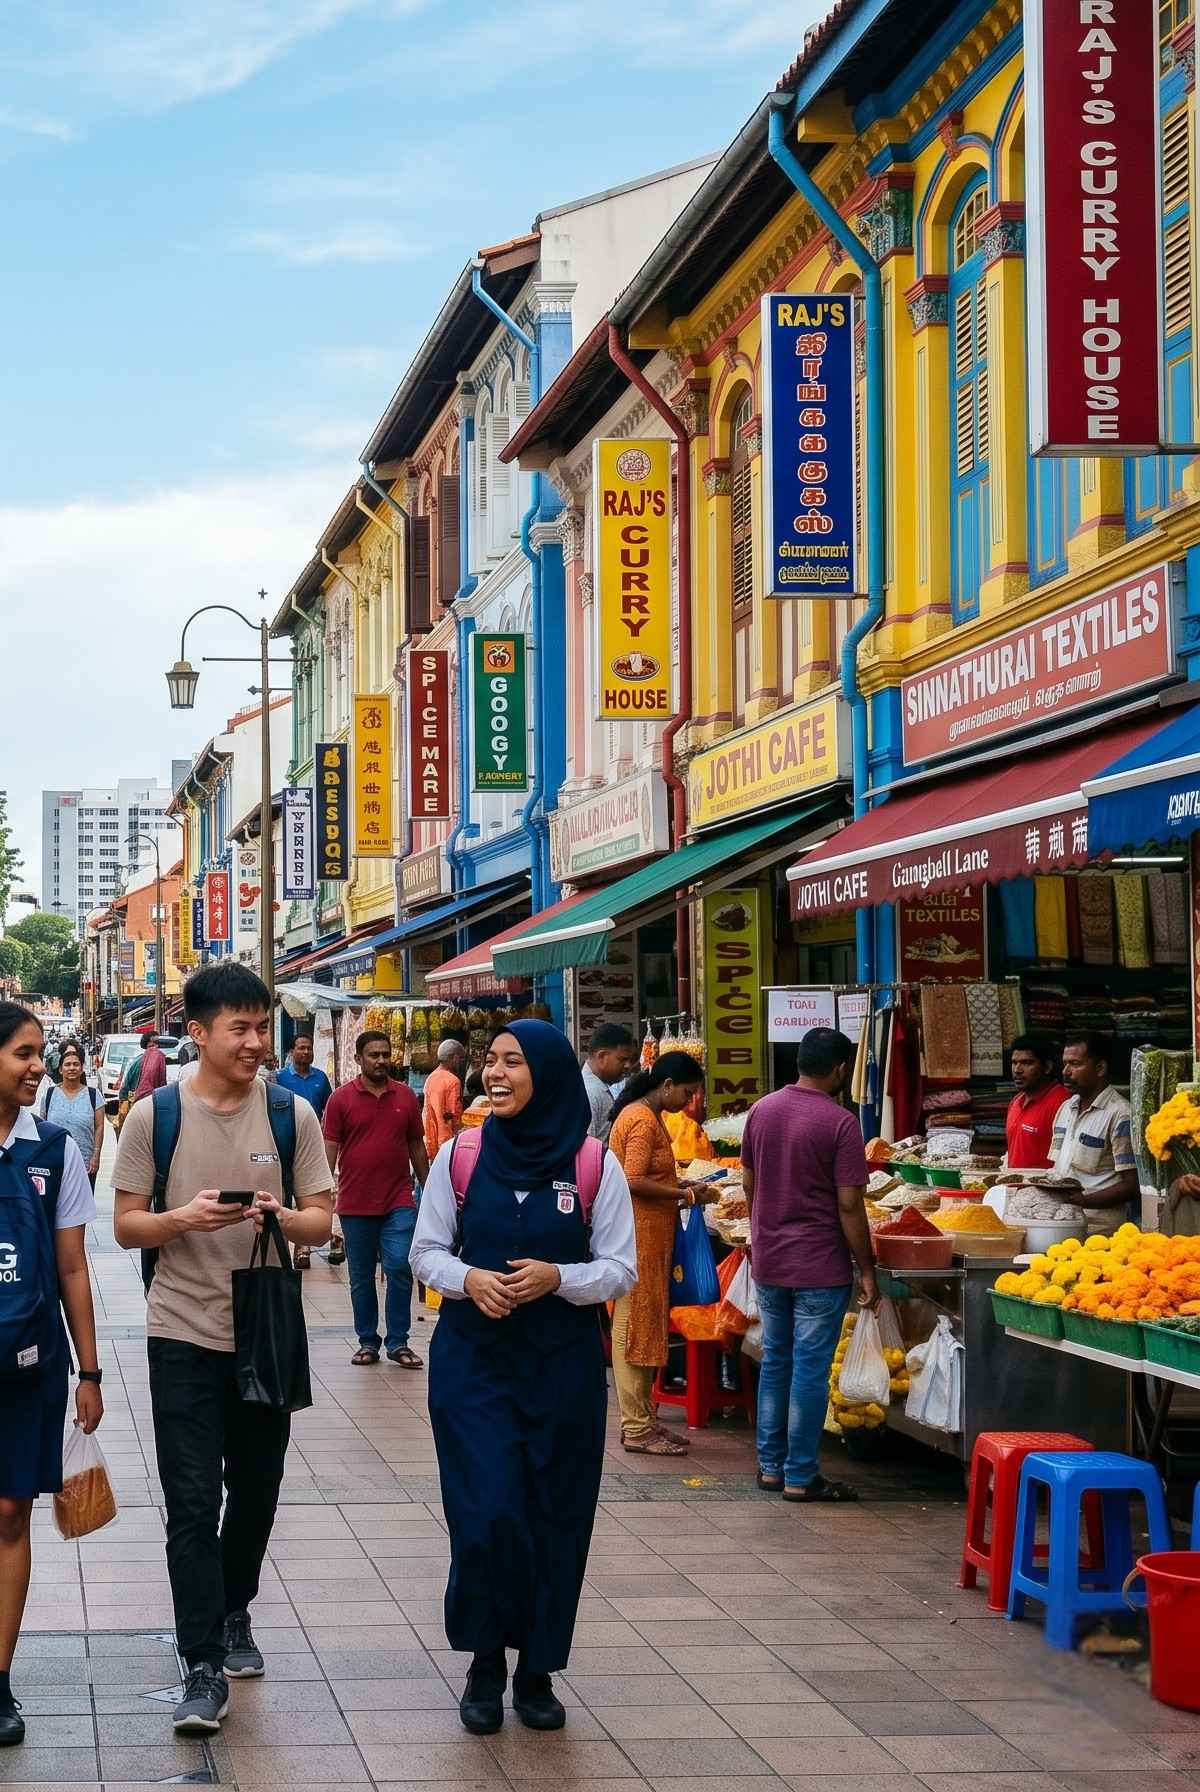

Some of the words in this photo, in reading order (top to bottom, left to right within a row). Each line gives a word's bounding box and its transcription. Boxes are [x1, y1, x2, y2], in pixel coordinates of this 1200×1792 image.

[1080, 141, 1121, 281] CURRY
[777, 303, 845, 327] RAJ'S
[1082, 298, 1121, 439] HOUSE
[603, 489, 666, 517] RAJ'S
[620, 525, 650, 638] CURRY
[907, 633, 1036, 726] SINNATHURAI
[1042, 579, 1160, 673] TEXTILES
[421, 655, 437, 739] SPICE
[490, 676, 508, 771] GOOGY
[604, 688, 667, 710] HOUSE
[420, 746, 439, 813] MARE
[706, 739, 762, 800] JOTHI
[768, 712, 826, 775] CAFE
[834, 870, 868, 903] CAFE
[955, 848, 989, 875] Lane
